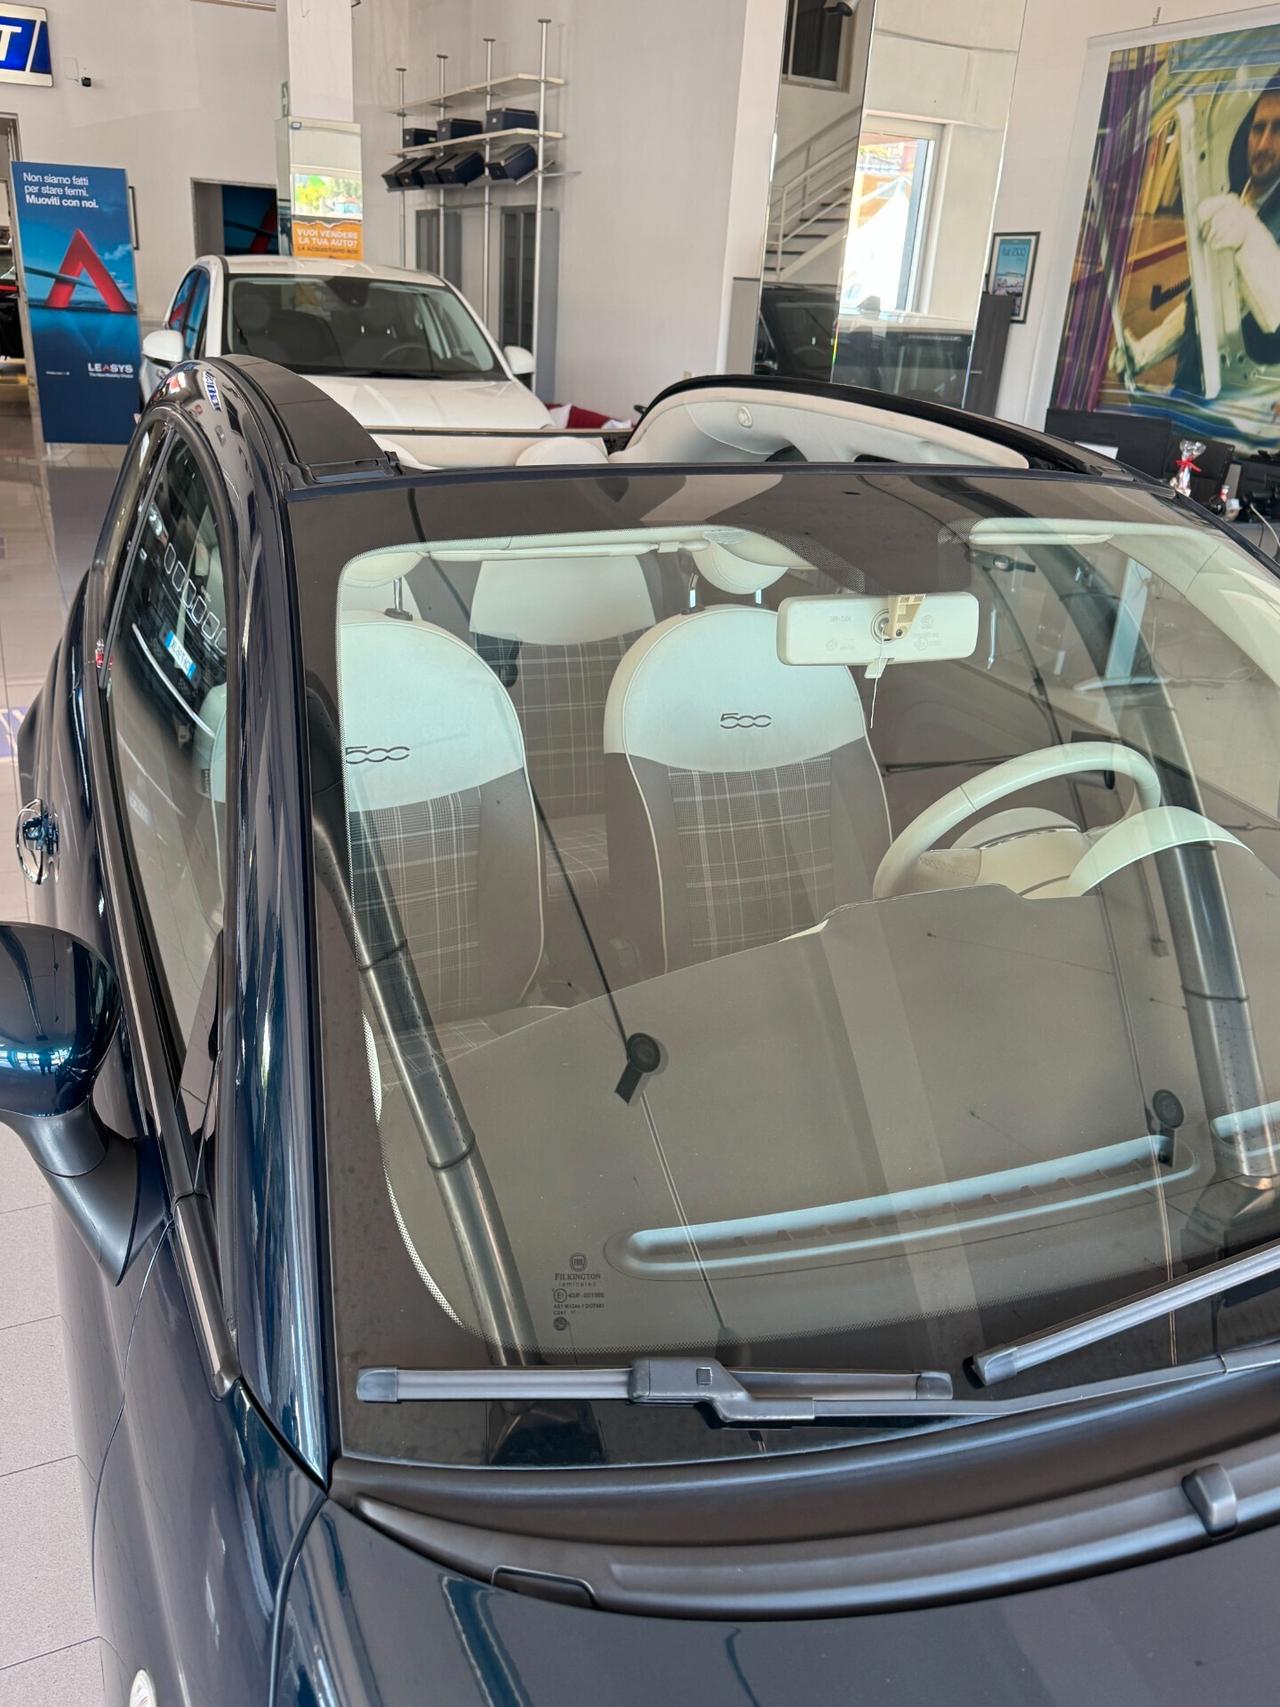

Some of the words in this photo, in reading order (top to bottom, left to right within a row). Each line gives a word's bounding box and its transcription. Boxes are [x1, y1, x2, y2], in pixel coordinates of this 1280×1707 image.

[23, 172, 42, 182] Non
[44, 174, 70, 184] siamo
[72, 176, 89, 186] fatti
[24, 185, 39, 194] per
[41, 185, 63, 195] stare
[65, 186, 89, 197] fermi.
[25, 194, 60, 206] Muoviti
[62, 199, 80, 207] con
[82, 199, 99, 208] noi.
[296, 229, 318, 237] VUOI
[320, 230, 358, 239] VENDERE
[311, 238, 329, 246] TUA
[87, 362, 134, 374] LEASYS
[720, 712, 772, 729] 500
[345, 745, 411, 765] 500
